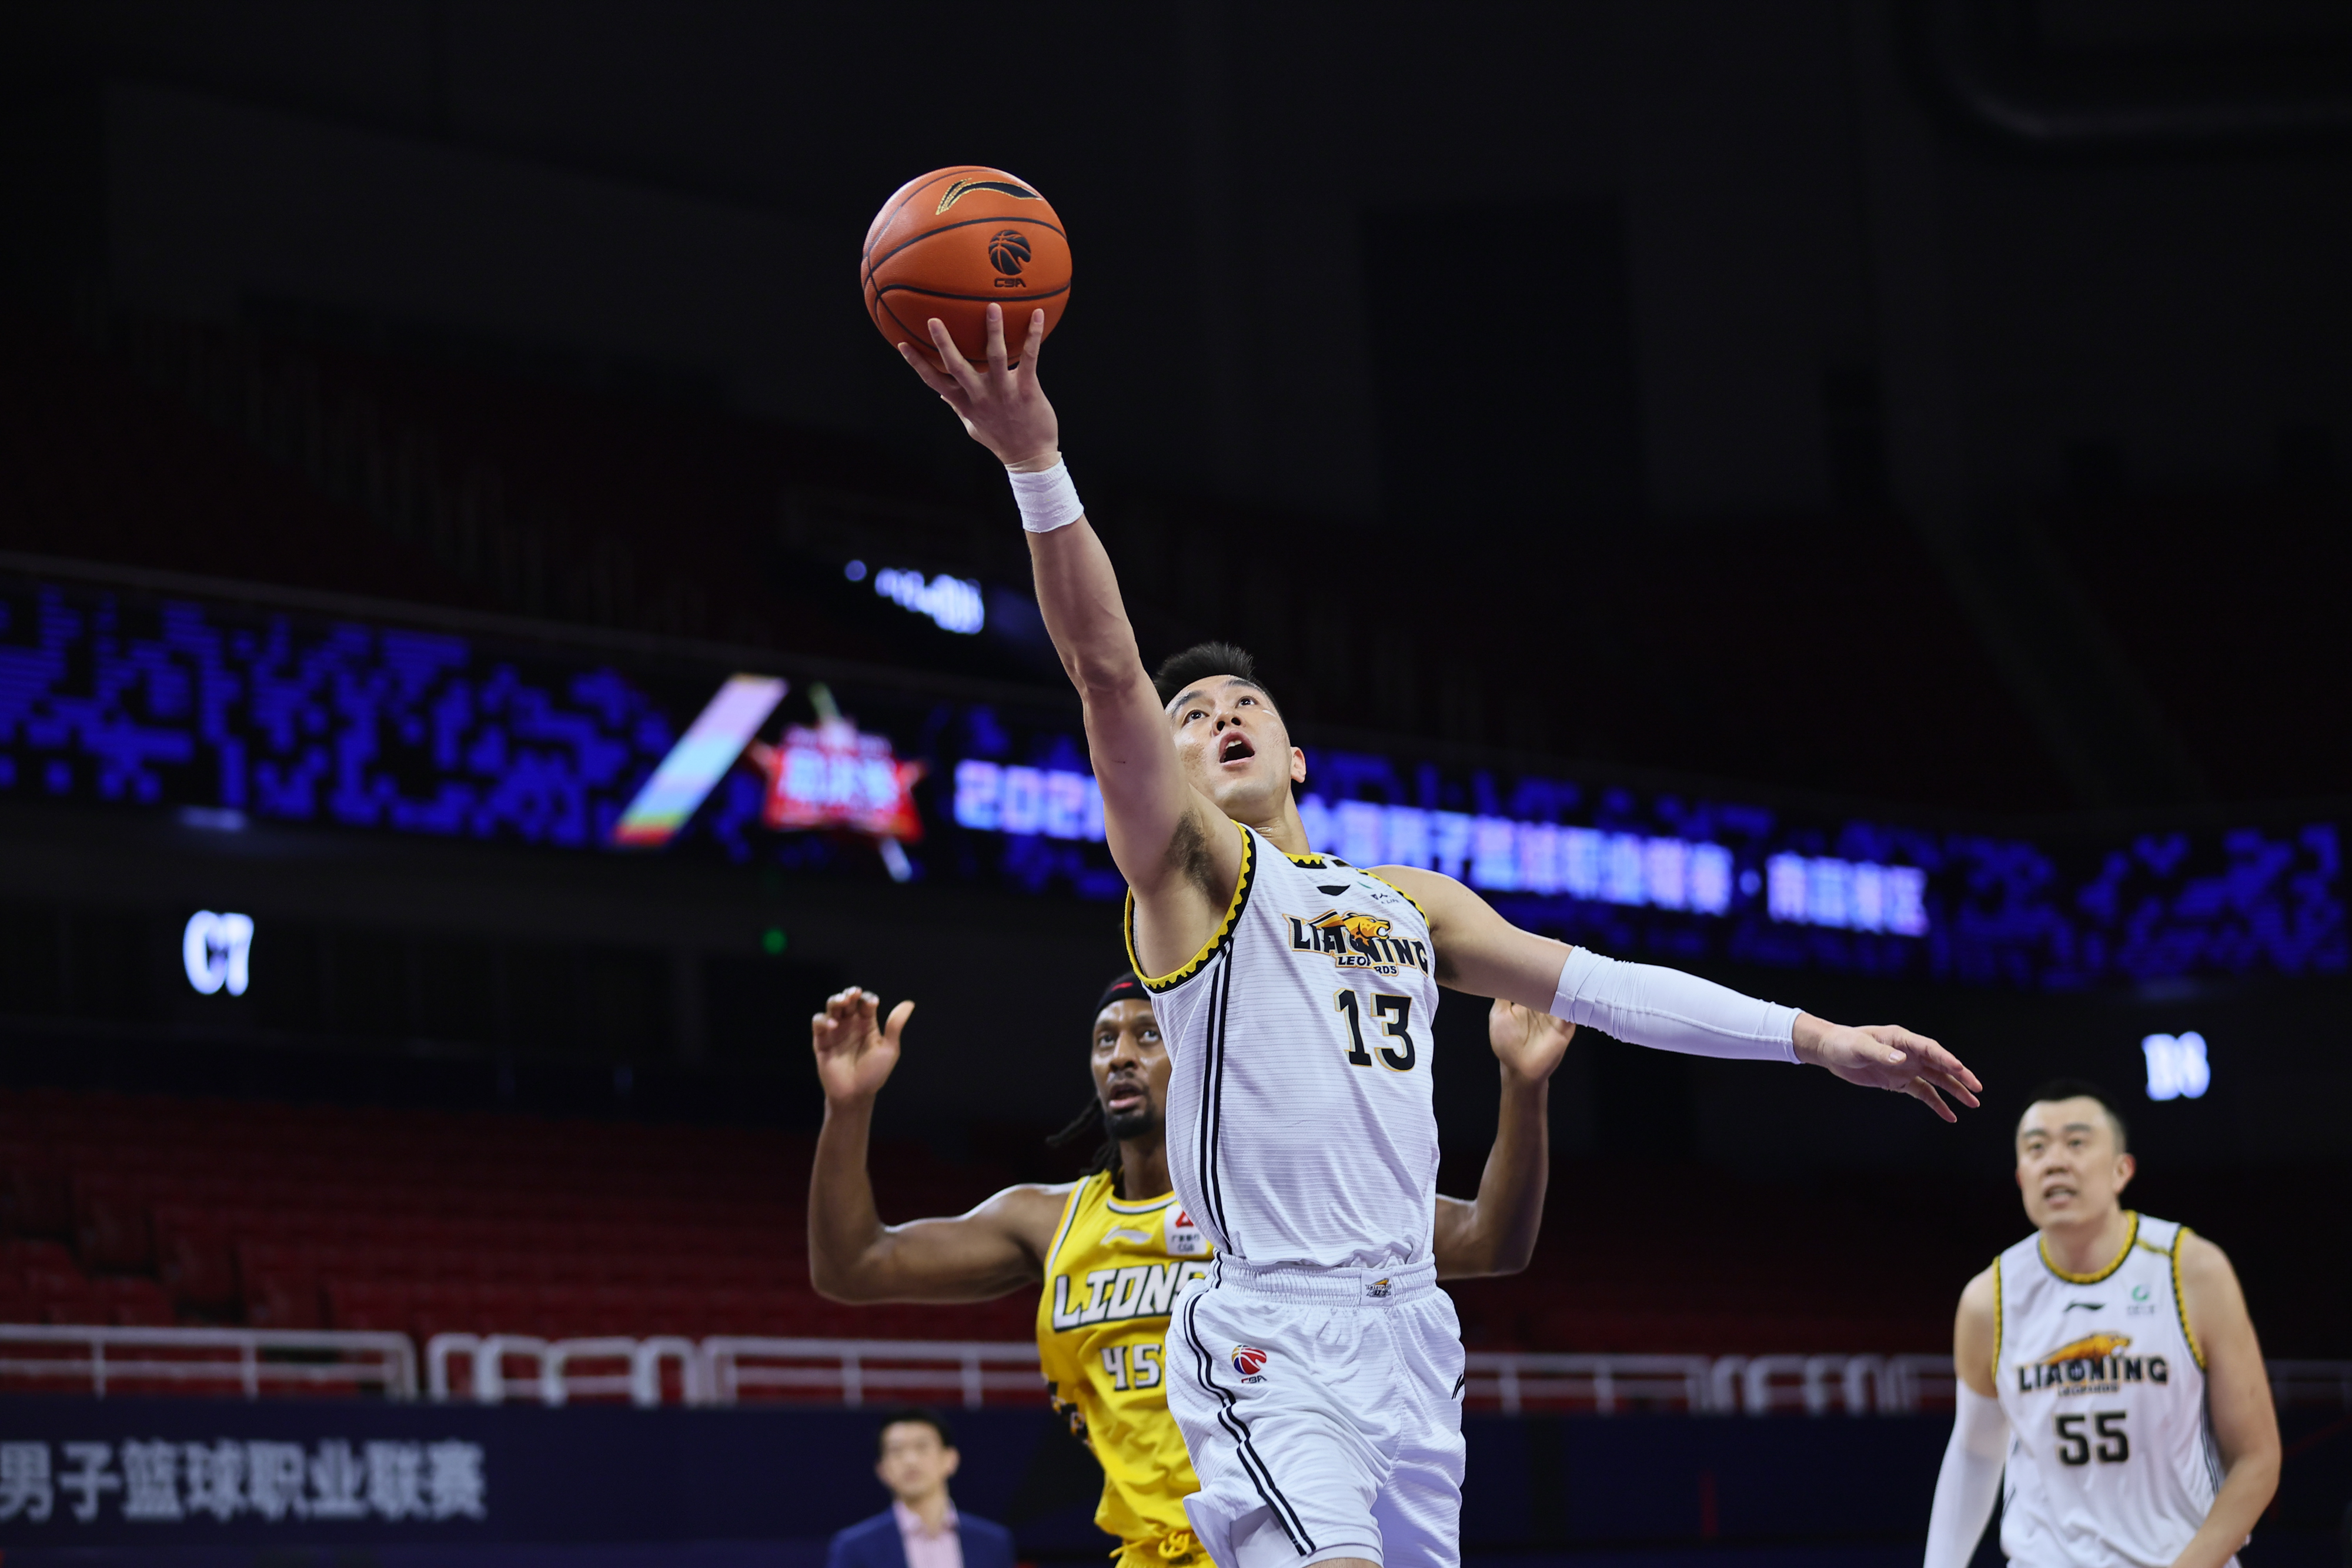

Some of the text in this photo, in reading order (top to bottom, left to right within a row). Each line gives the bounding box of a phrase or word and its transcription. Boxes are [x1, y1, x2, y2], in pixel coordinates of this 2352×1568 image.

[994, 277, 1027, 288] CBA
[1287, 915, 1429, 976] LIAONING
[1333, 988, 1416, 1072] 13
[1100, 1343, 1161, 1392] 45
[2017, 1355, 2169, 1392] LIAONING
[2054, 1410, 2130, 1466] 55
[0, 1437, 487, 1523] 男子篮球职业联赛
